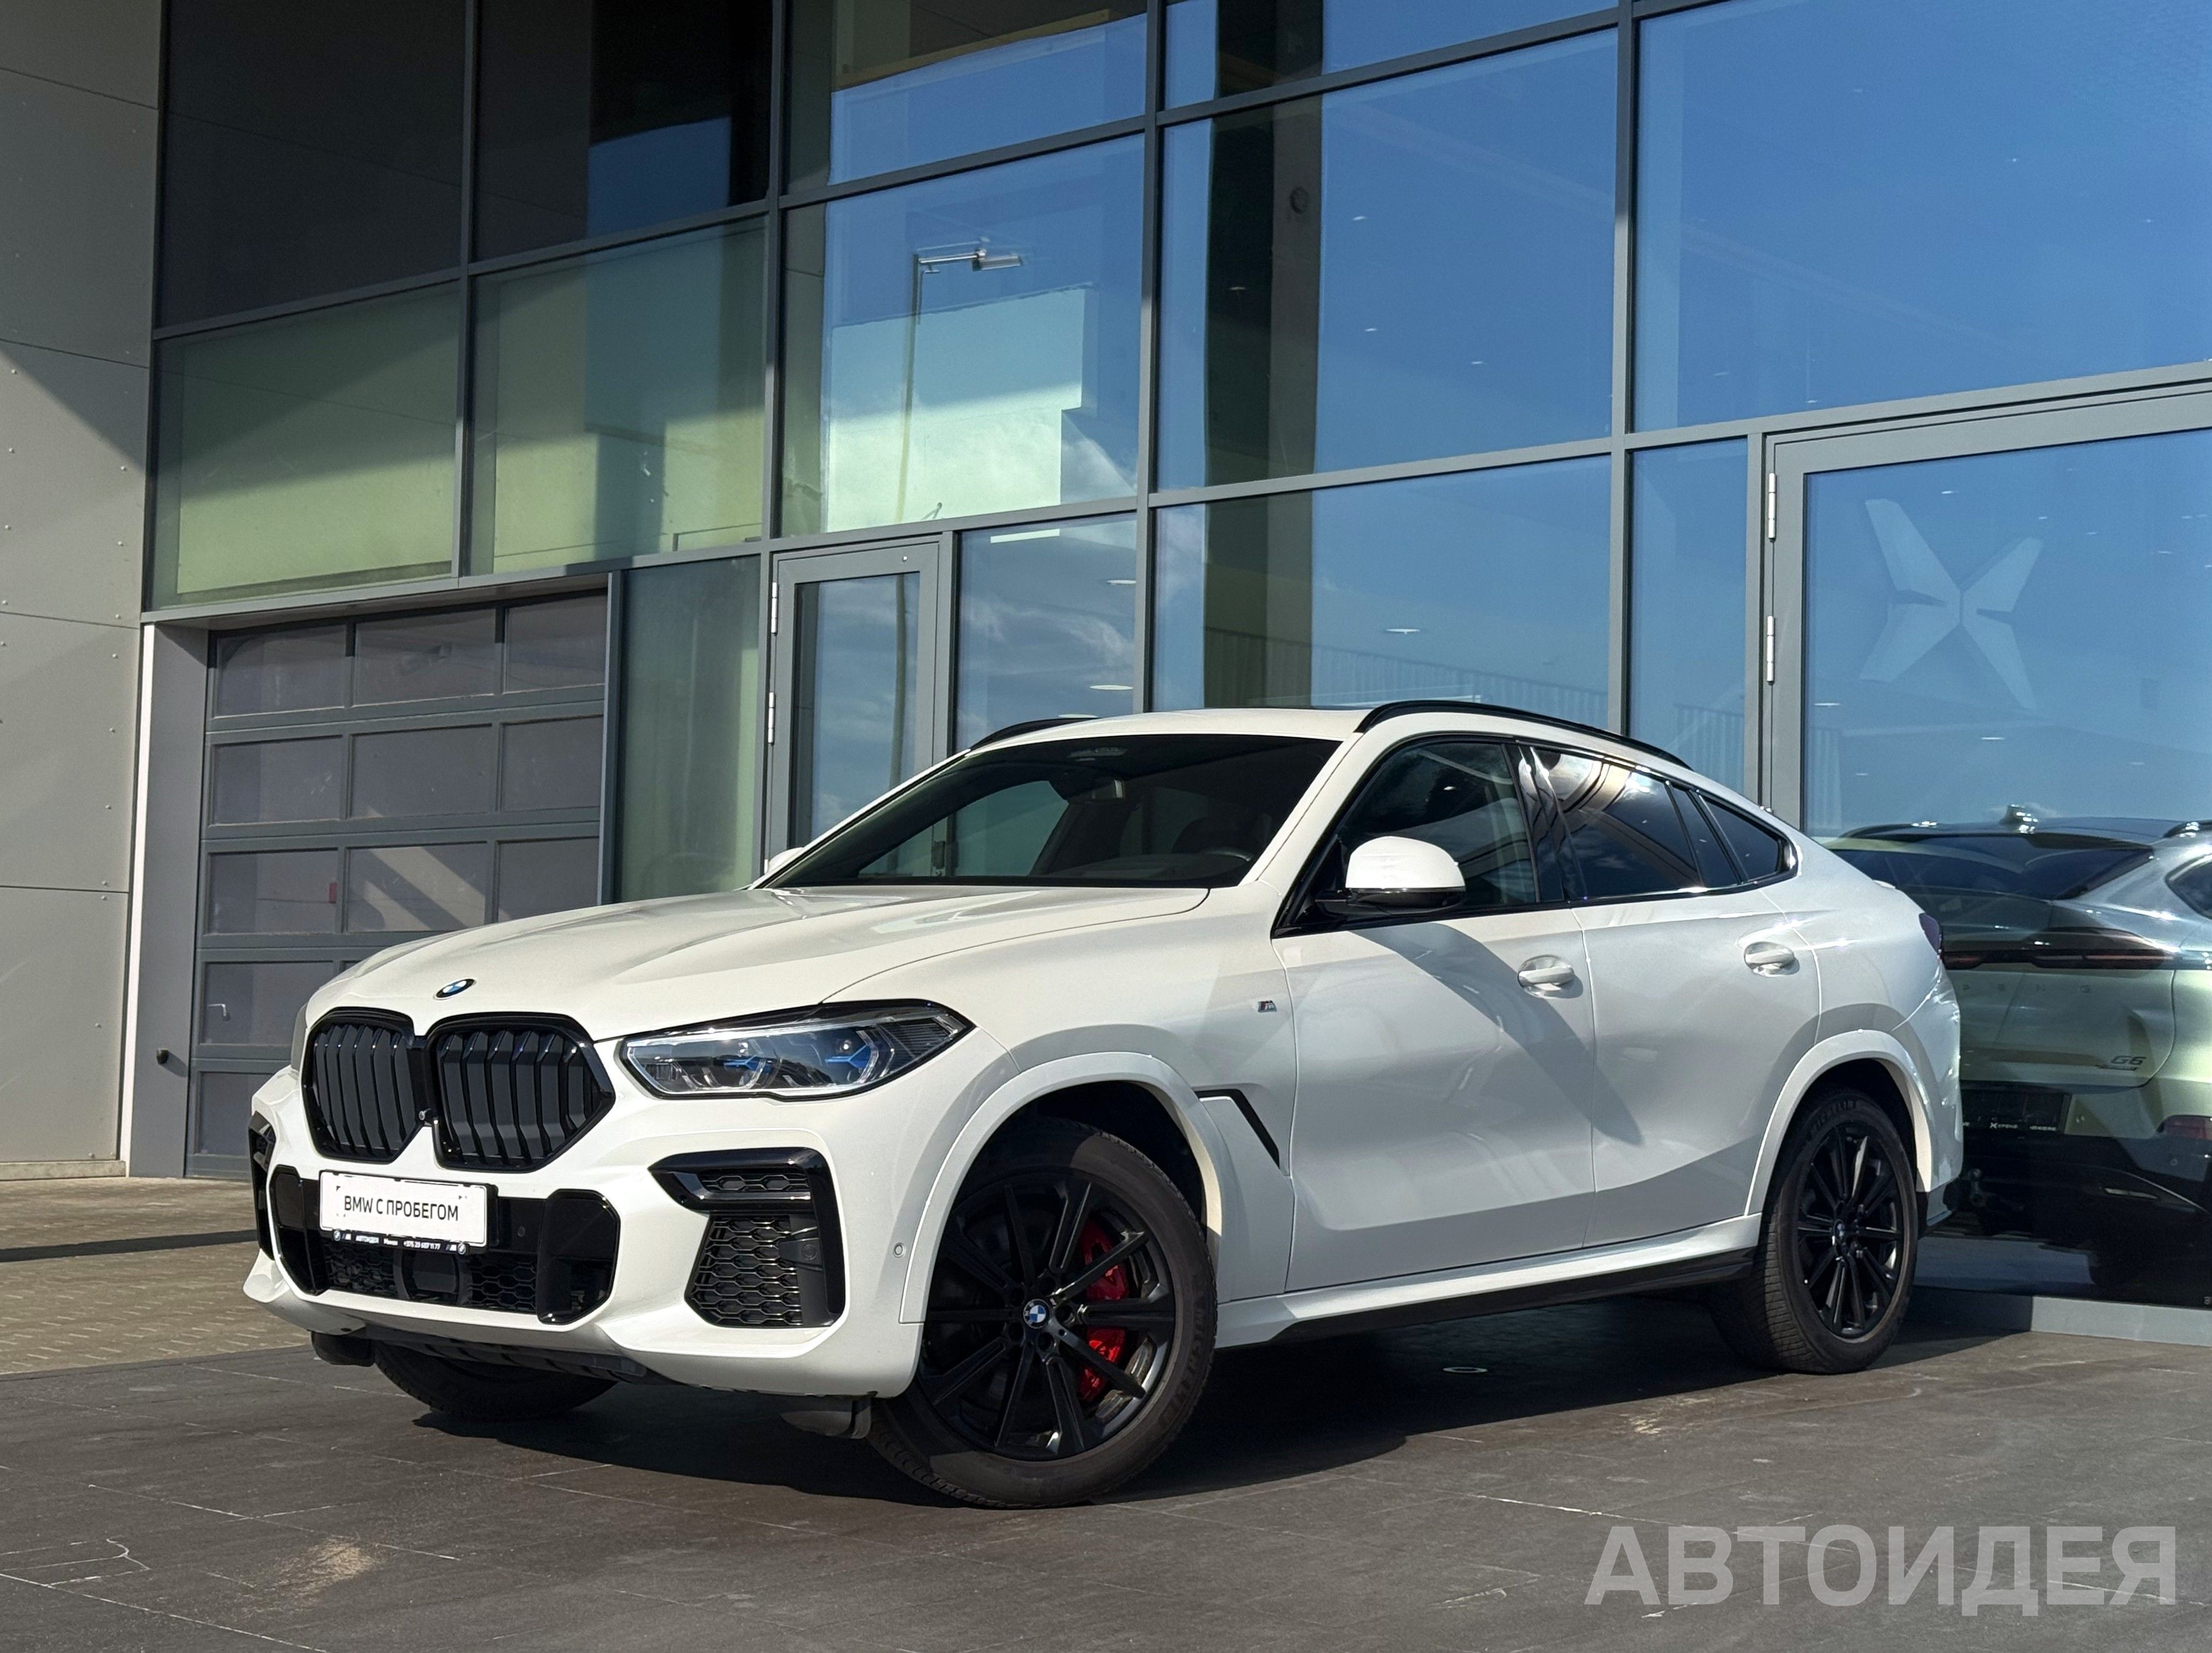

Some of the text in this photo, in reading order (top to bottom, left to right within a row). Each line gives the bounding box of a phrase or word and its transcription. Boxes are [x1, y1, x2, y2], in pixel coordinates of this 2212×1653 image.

[2111, 1055, 2147, 1065] G6
[344, 1196, 373, 1214] BMW
[387, 1200, 458, 1221] ПРОБЕГОМ
